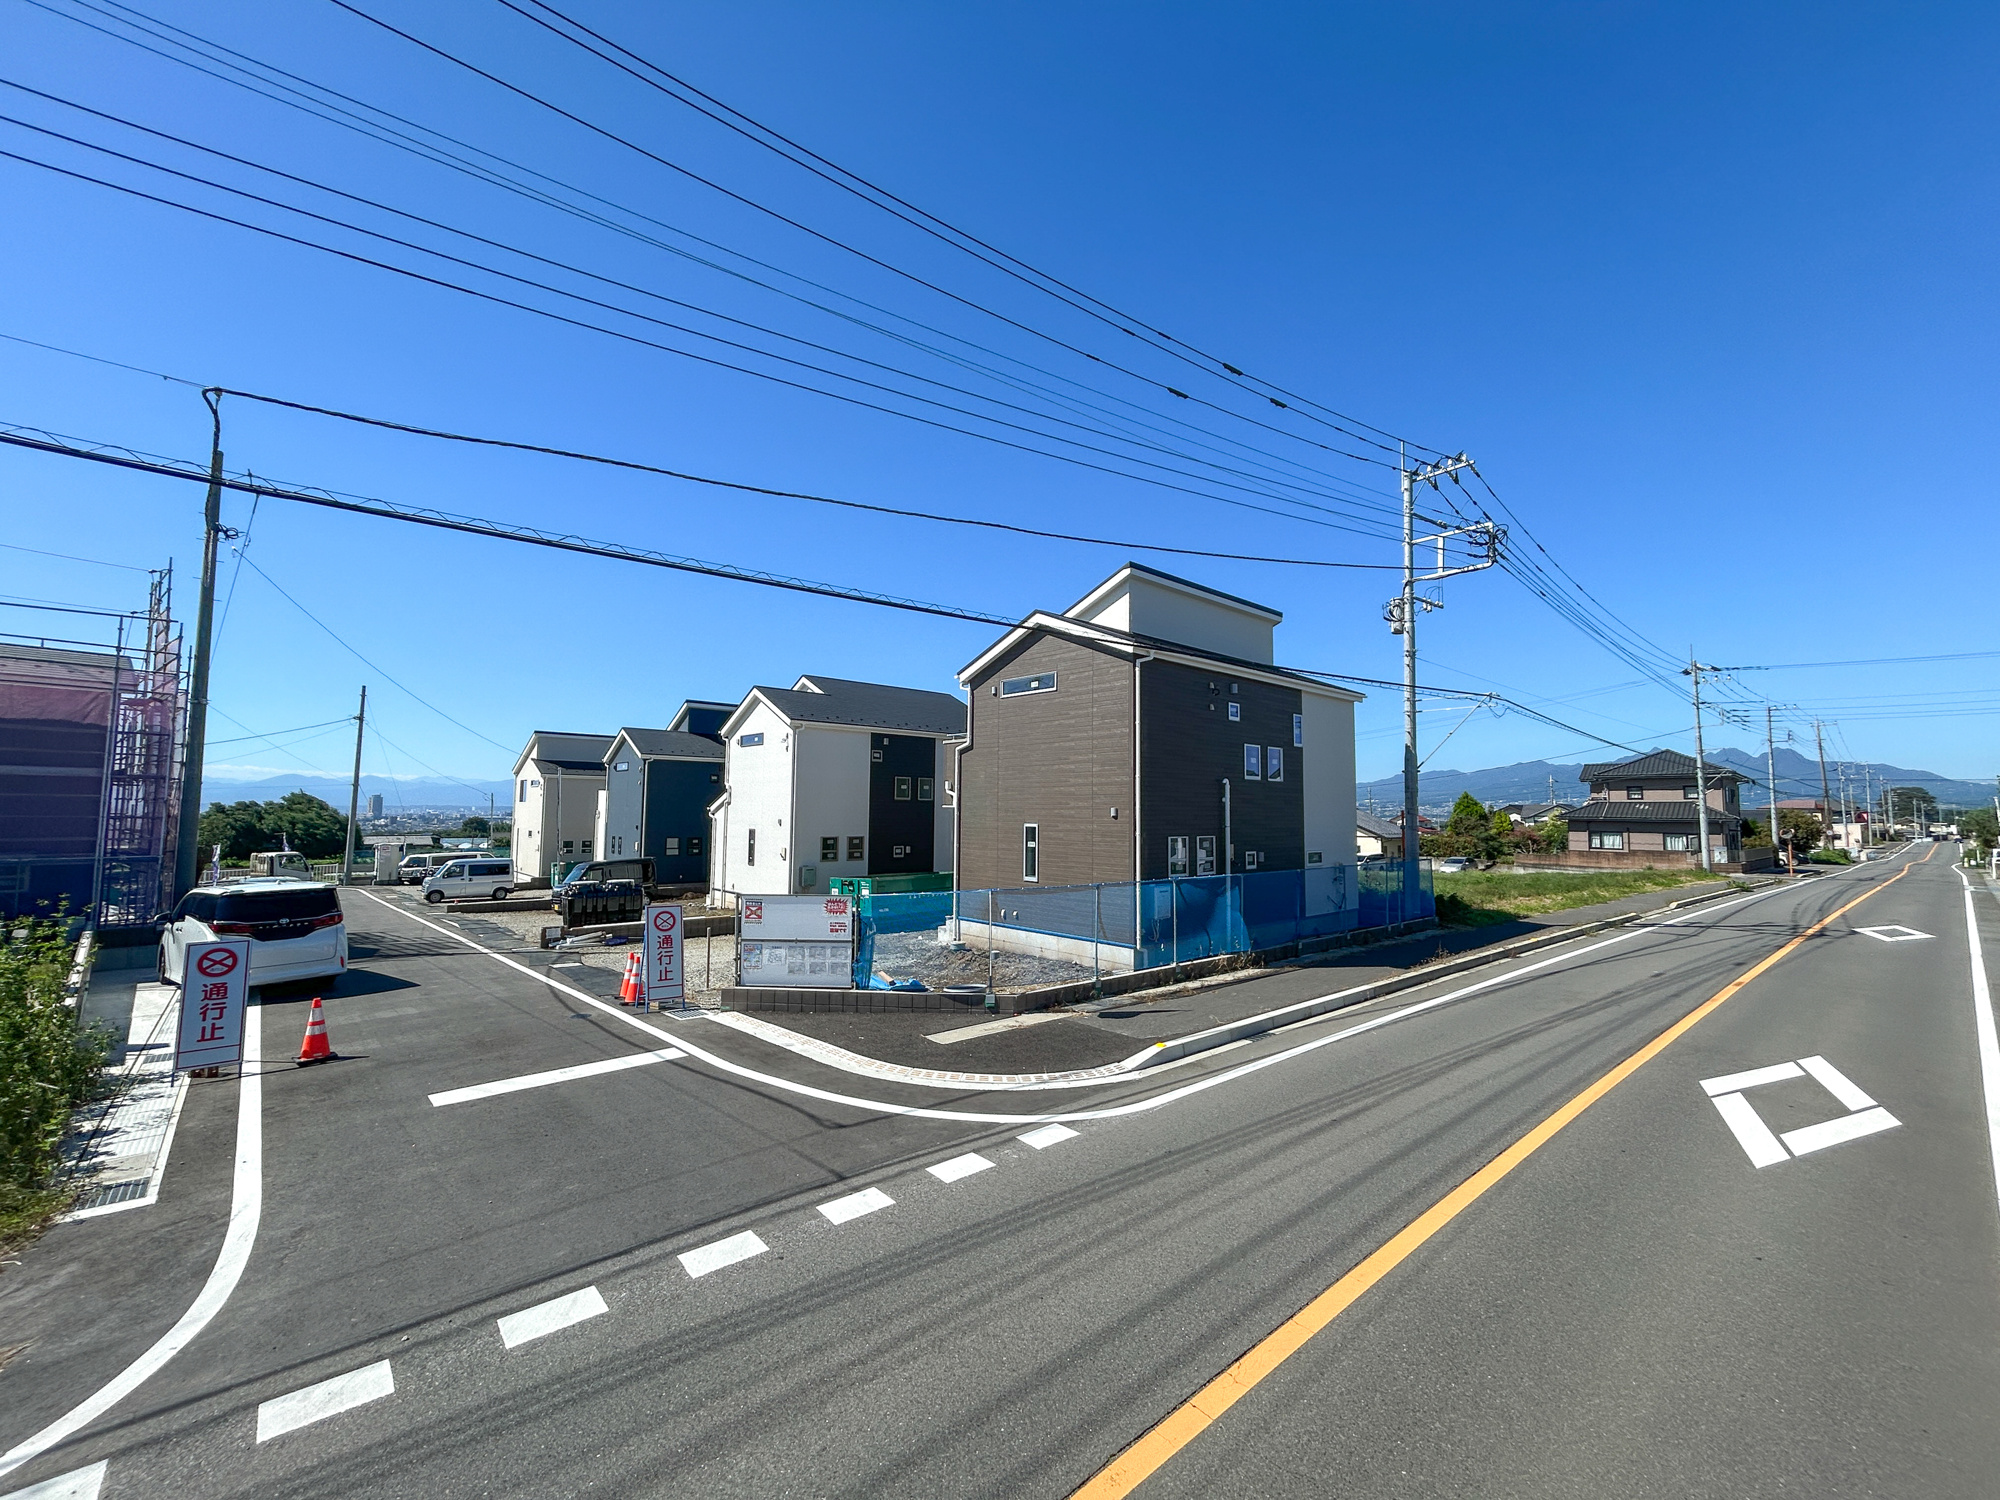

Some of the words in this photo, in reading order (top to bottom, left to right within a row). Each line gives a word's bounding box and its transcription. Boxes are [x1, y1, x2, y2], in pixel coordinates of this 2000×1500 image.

[656, 934, 674, 982] 通行止
[196, 982, 228, 1042] 通行止
